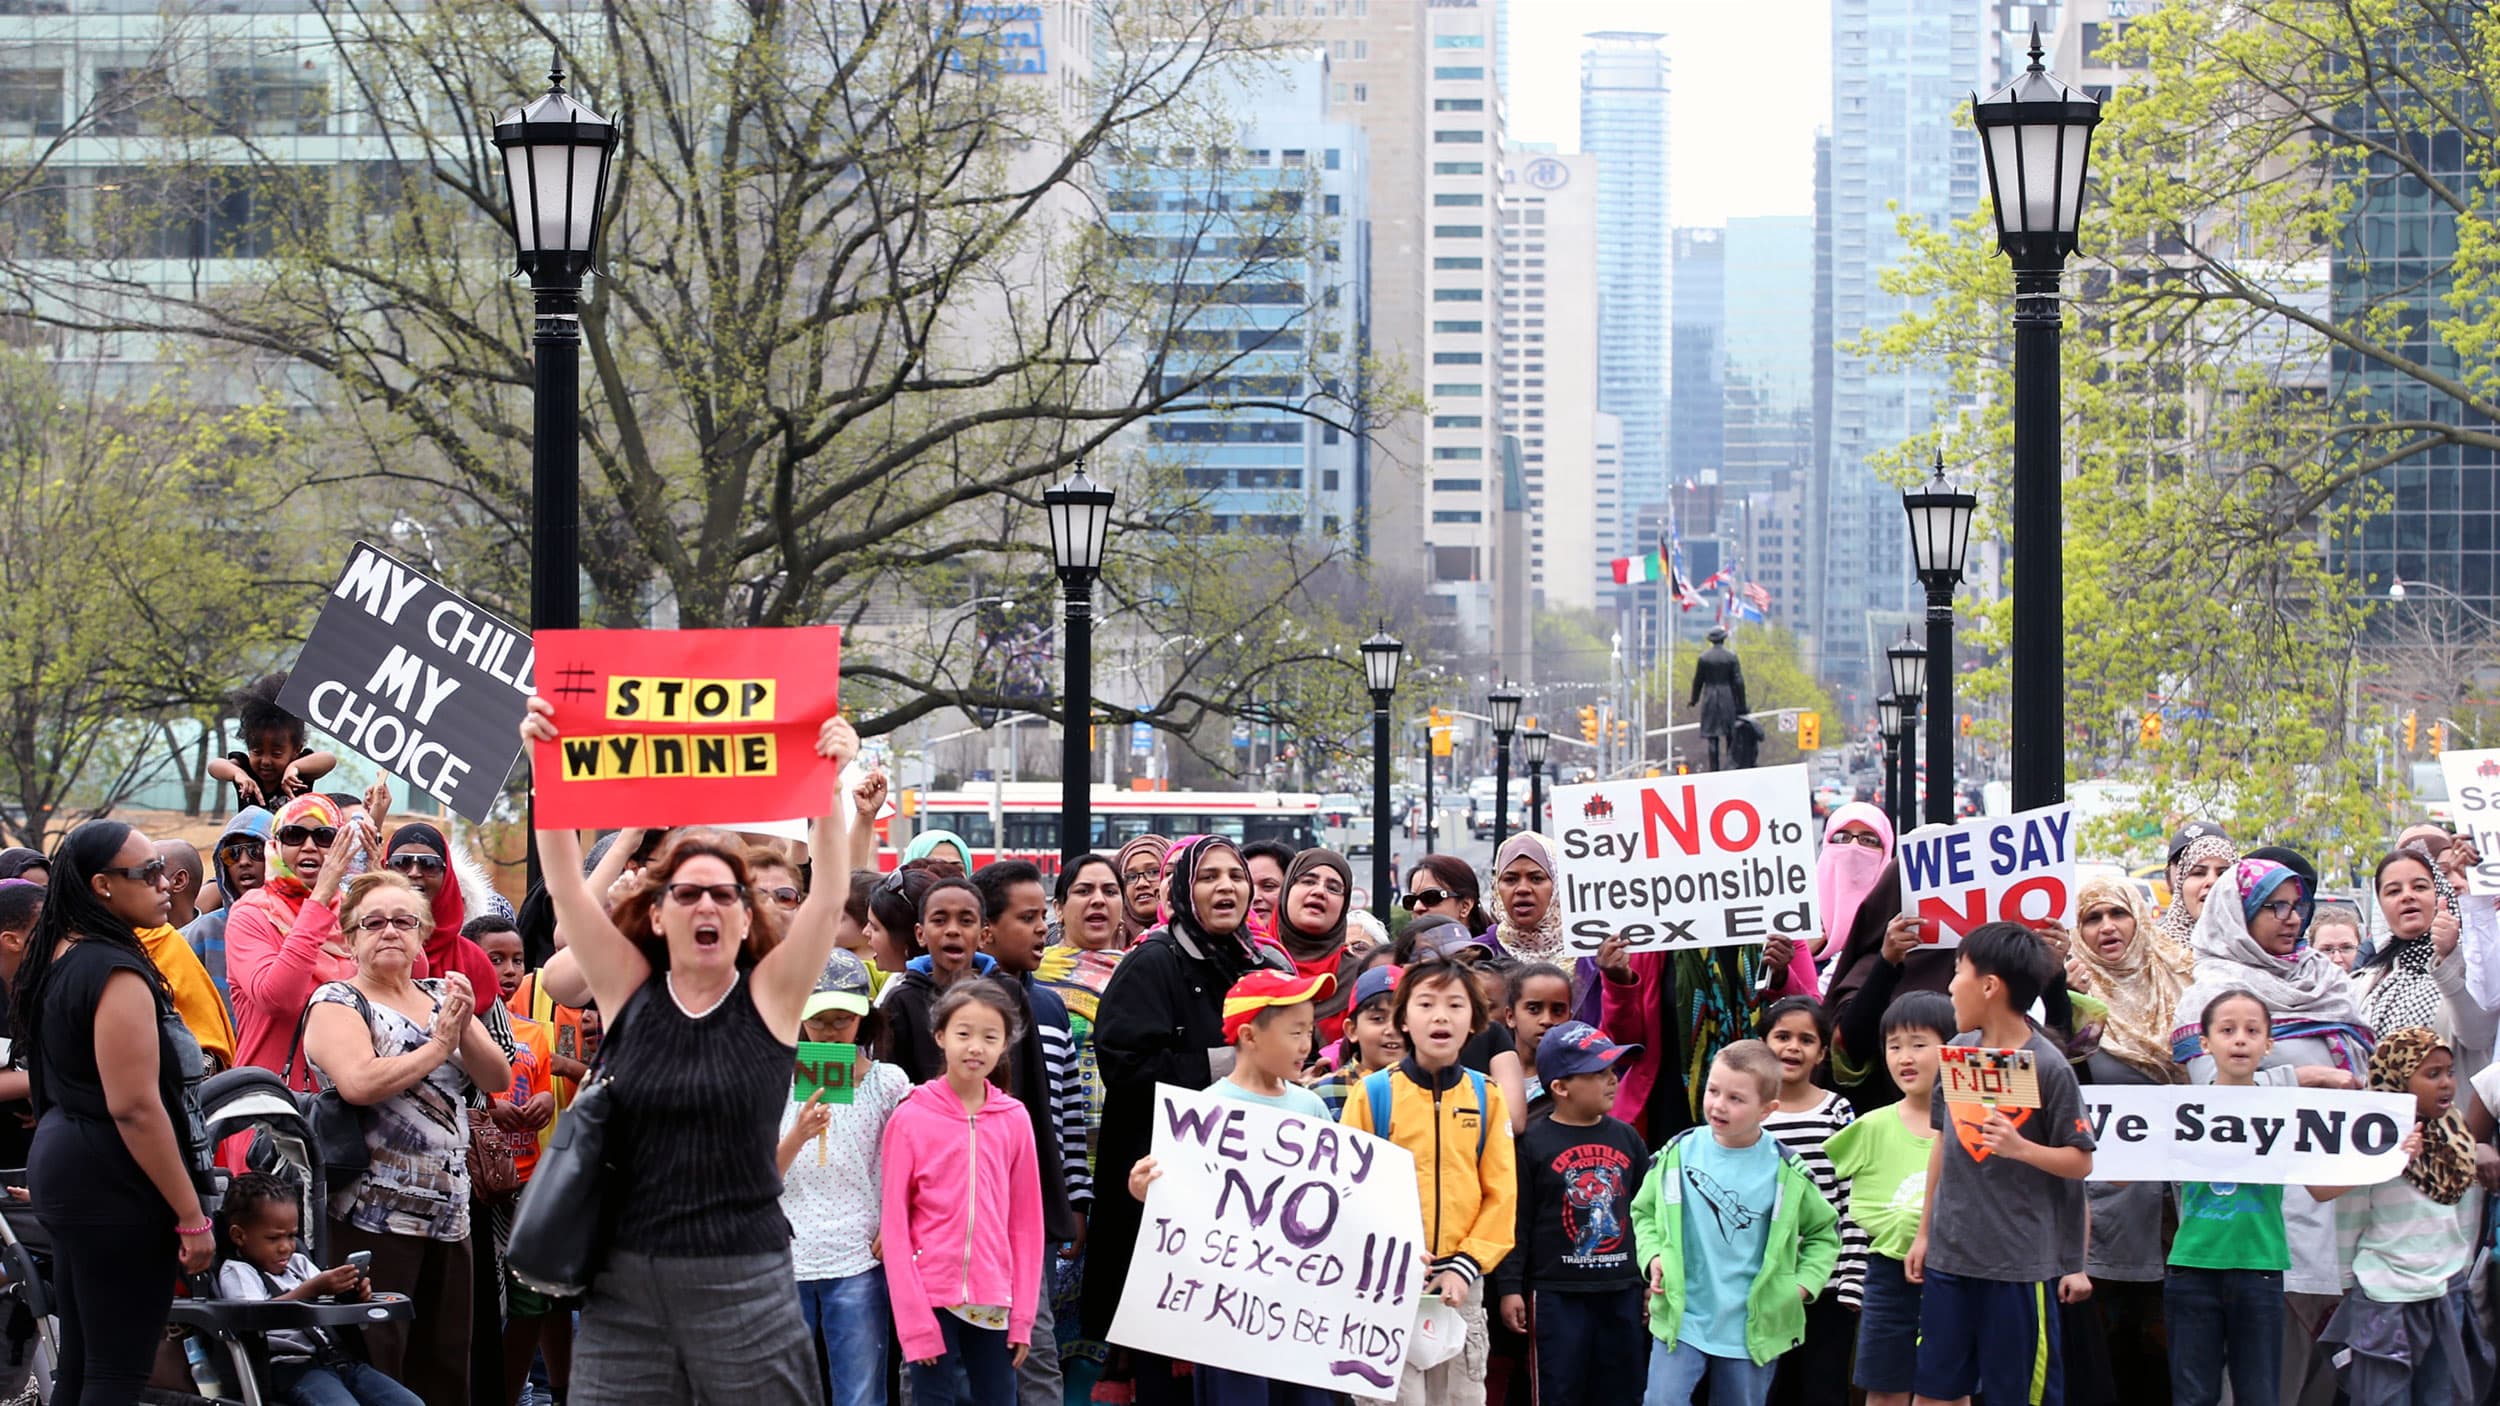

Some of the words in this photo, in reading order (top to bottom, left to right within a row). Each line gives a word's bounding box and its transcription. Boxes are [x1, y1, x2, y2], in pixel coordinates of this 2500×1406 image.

[334, 549, 427, 626] MY
[365, 644, 461, 726] MY
[615, 680, 767, 717] STOP
[308, 680, 472, 806] CHOICE
[1564, 828, 1639, 863] Say
[1640, 785, 1761, 859] No
[1768, 819, 1802, 845] to
[1901, 832, 1974, 892] WE
[1990, 811, 2070, 876] SAY
[1567, 856, 1807, 916] Irresponsible
[1918, 876, 2067, 944] NO
[1570, 919, 1698, 950] Sex
[1724, 902, 1812, 938] Ed
[1951, 1068, 2012, 1094] NO!
[1164, 1098, 1247, 1161] WE
[1263, 1118, 1374, 1184] SAY
[1551, 1144, 1631, 1174] OPTIMUS
[2175, 1103, 2284, 1155] Say
[2294, 1109, 2399, 1155] NO
[1156, 1218, 1186, 1255] TO
[1200, 1230, 1344, 1286] SEX-ED
[1203, 1283, 1286, 1341] KIDS
[1293, 1308, 1329, 1345] BE
